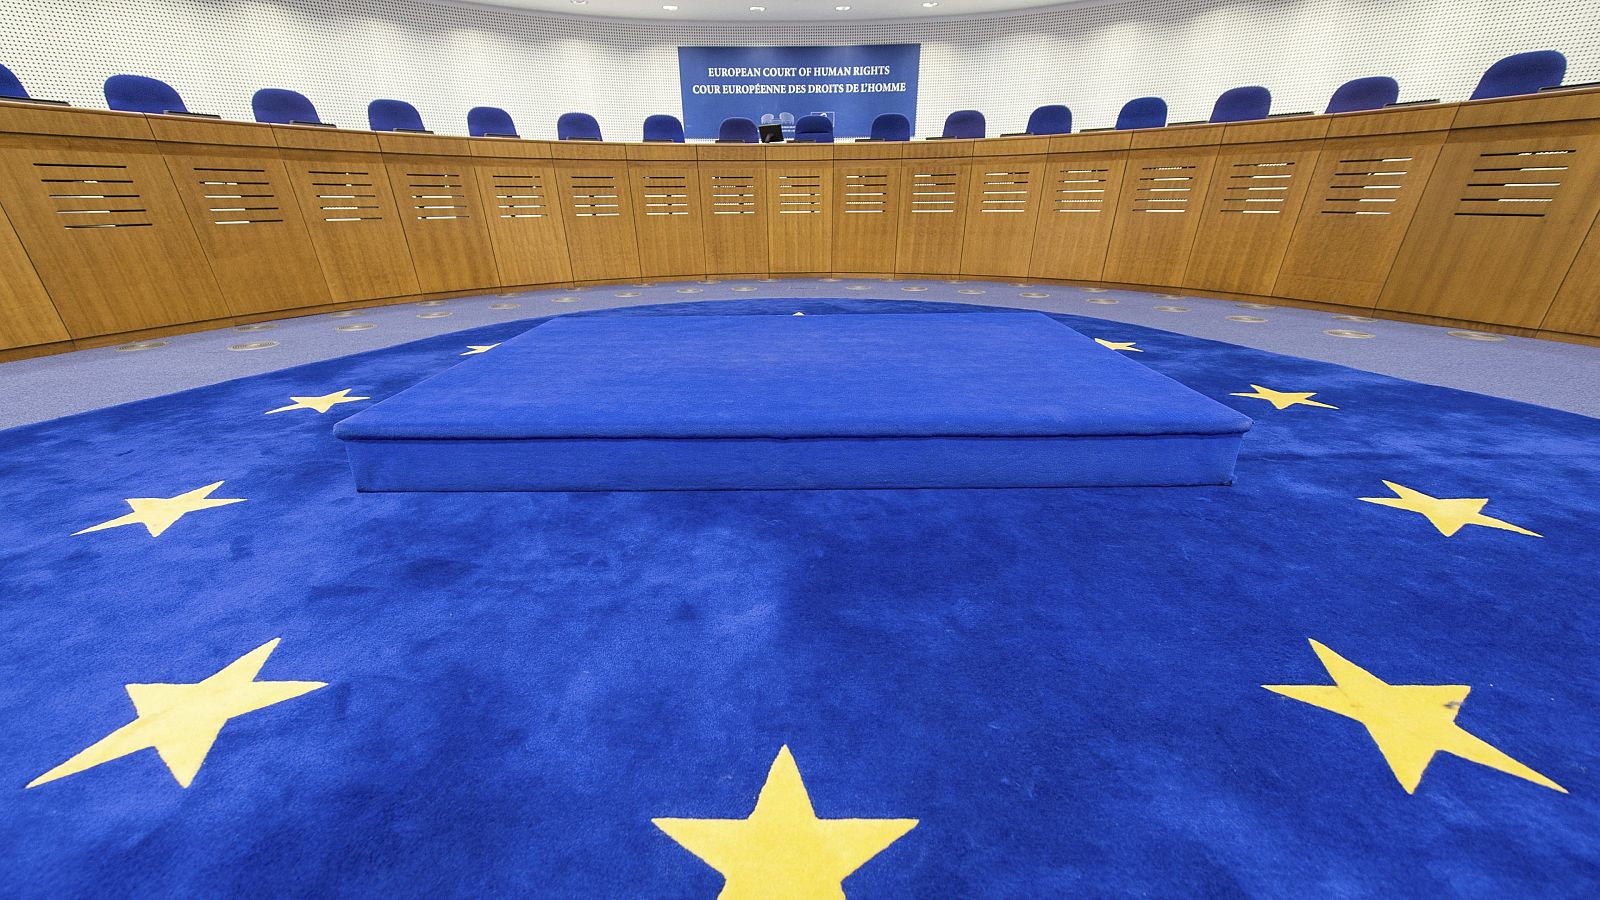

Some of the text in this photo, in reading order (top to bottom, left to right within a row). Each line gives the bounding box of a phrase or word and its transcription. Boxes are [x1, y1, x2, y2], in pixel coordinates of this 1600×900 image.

[708, 65, 890, 77] EUROPEAN COURT OF HUMAN RIGHTS
[692, 82, 906, 94] COUR EUROPÉENNE DES DROITS DE L'HOMME
